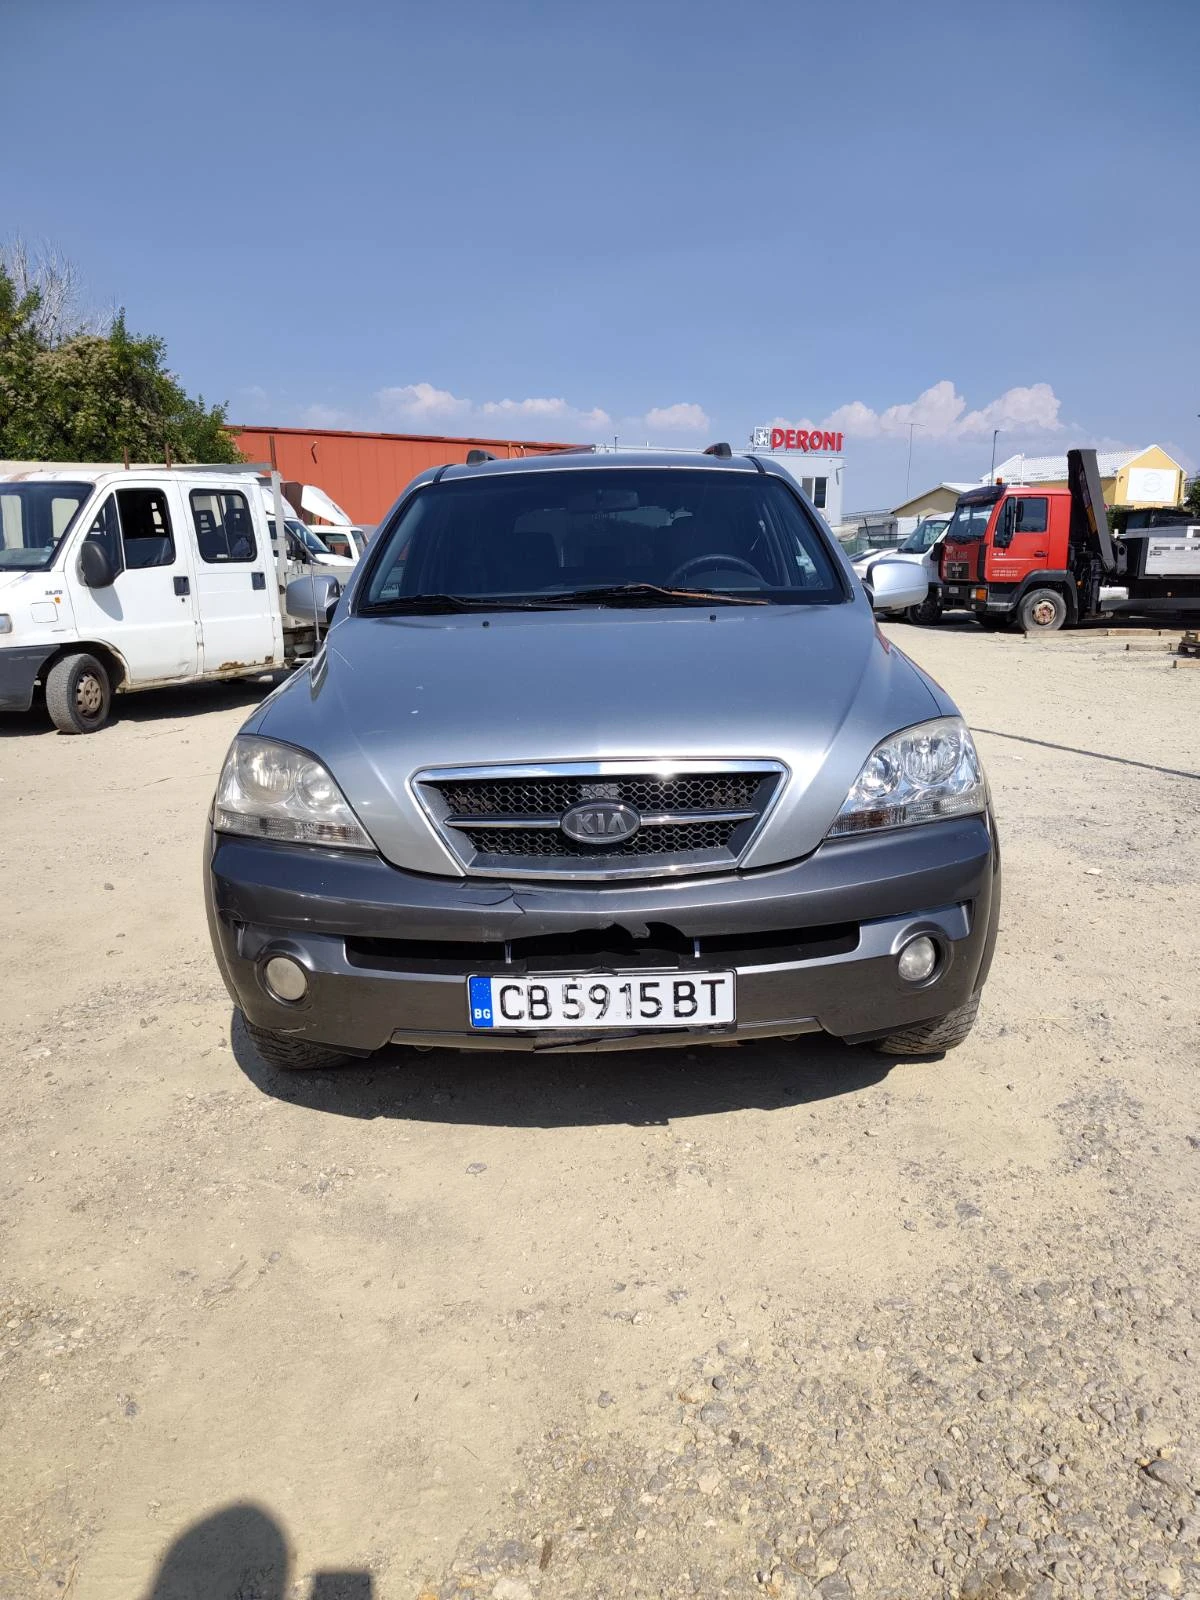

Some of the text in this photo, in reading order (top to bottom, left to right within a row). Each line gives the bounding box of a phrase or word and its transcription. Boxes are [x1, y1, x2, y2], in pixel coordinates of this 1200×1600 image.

[771, 428, 843, 453] DERONI
[575, 812, 628, 834] KIA
[474, 1008, 491, 1020] BG
